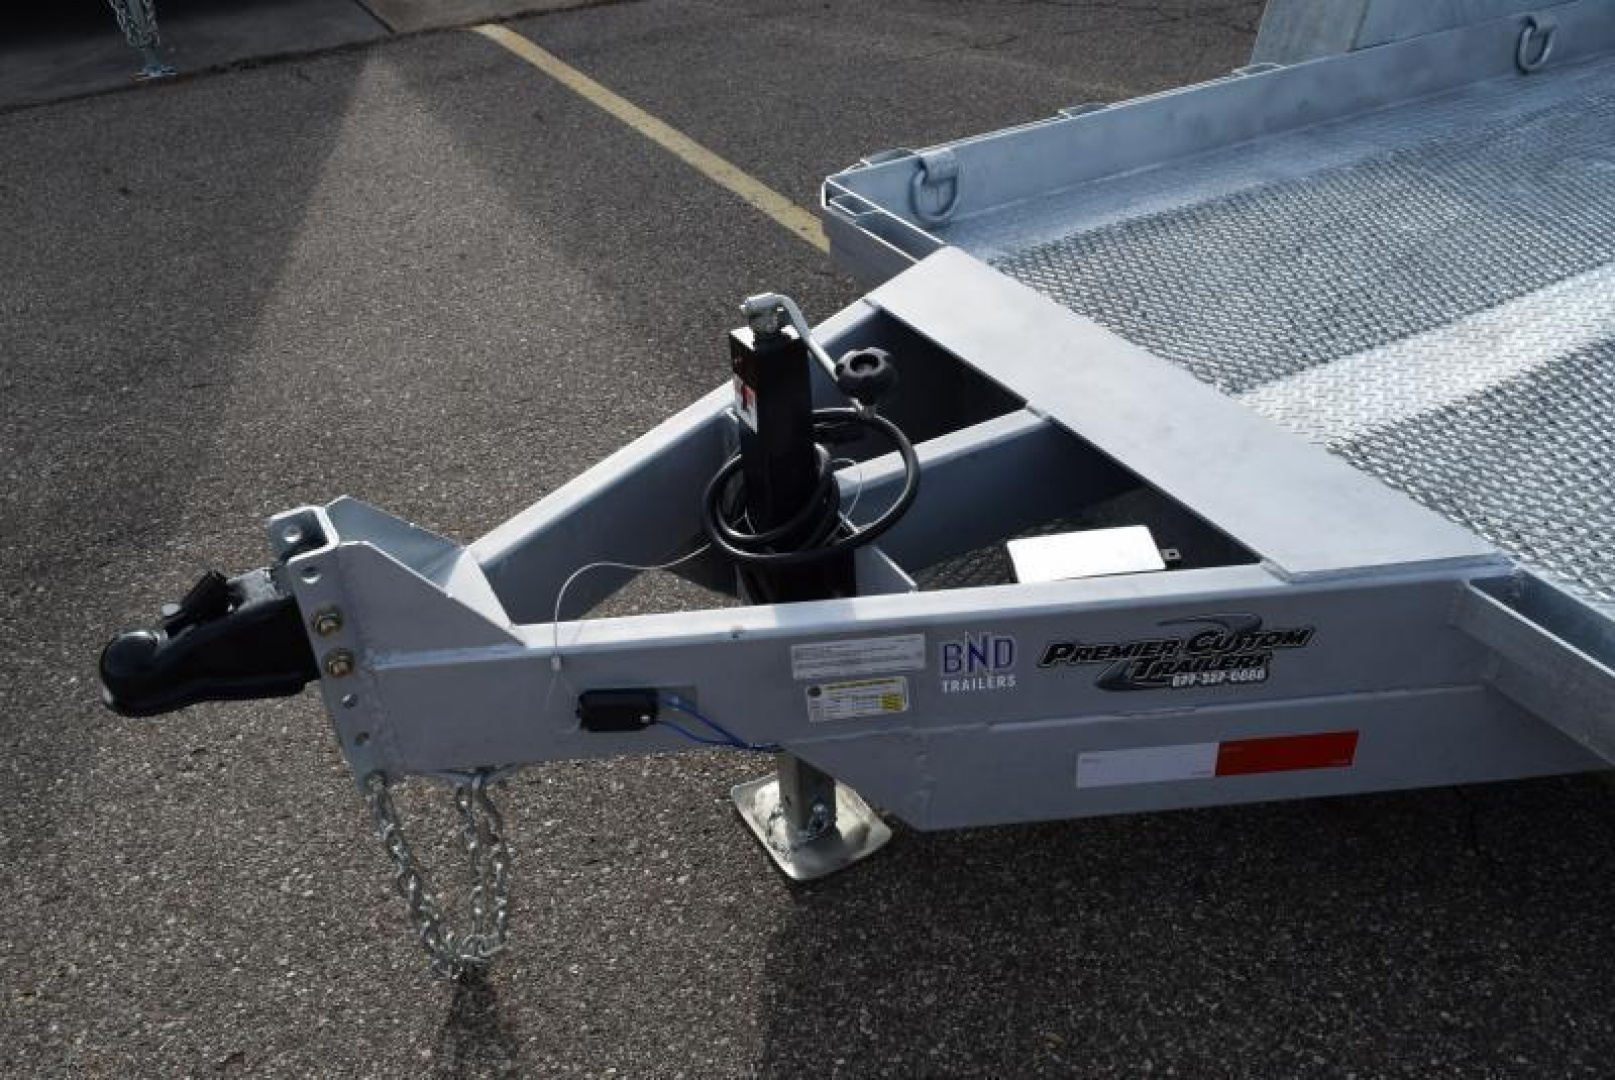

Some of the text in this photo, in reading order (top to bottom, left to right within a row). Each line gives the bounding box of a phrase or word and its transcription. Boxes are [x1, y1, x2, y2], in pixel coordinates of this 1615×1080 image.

[943, 633, 1016, 674] BND
[1039, 627, 1316, 667] PREMIER CUSTOM
[941, 674, 1017, 694] TRAILERS
